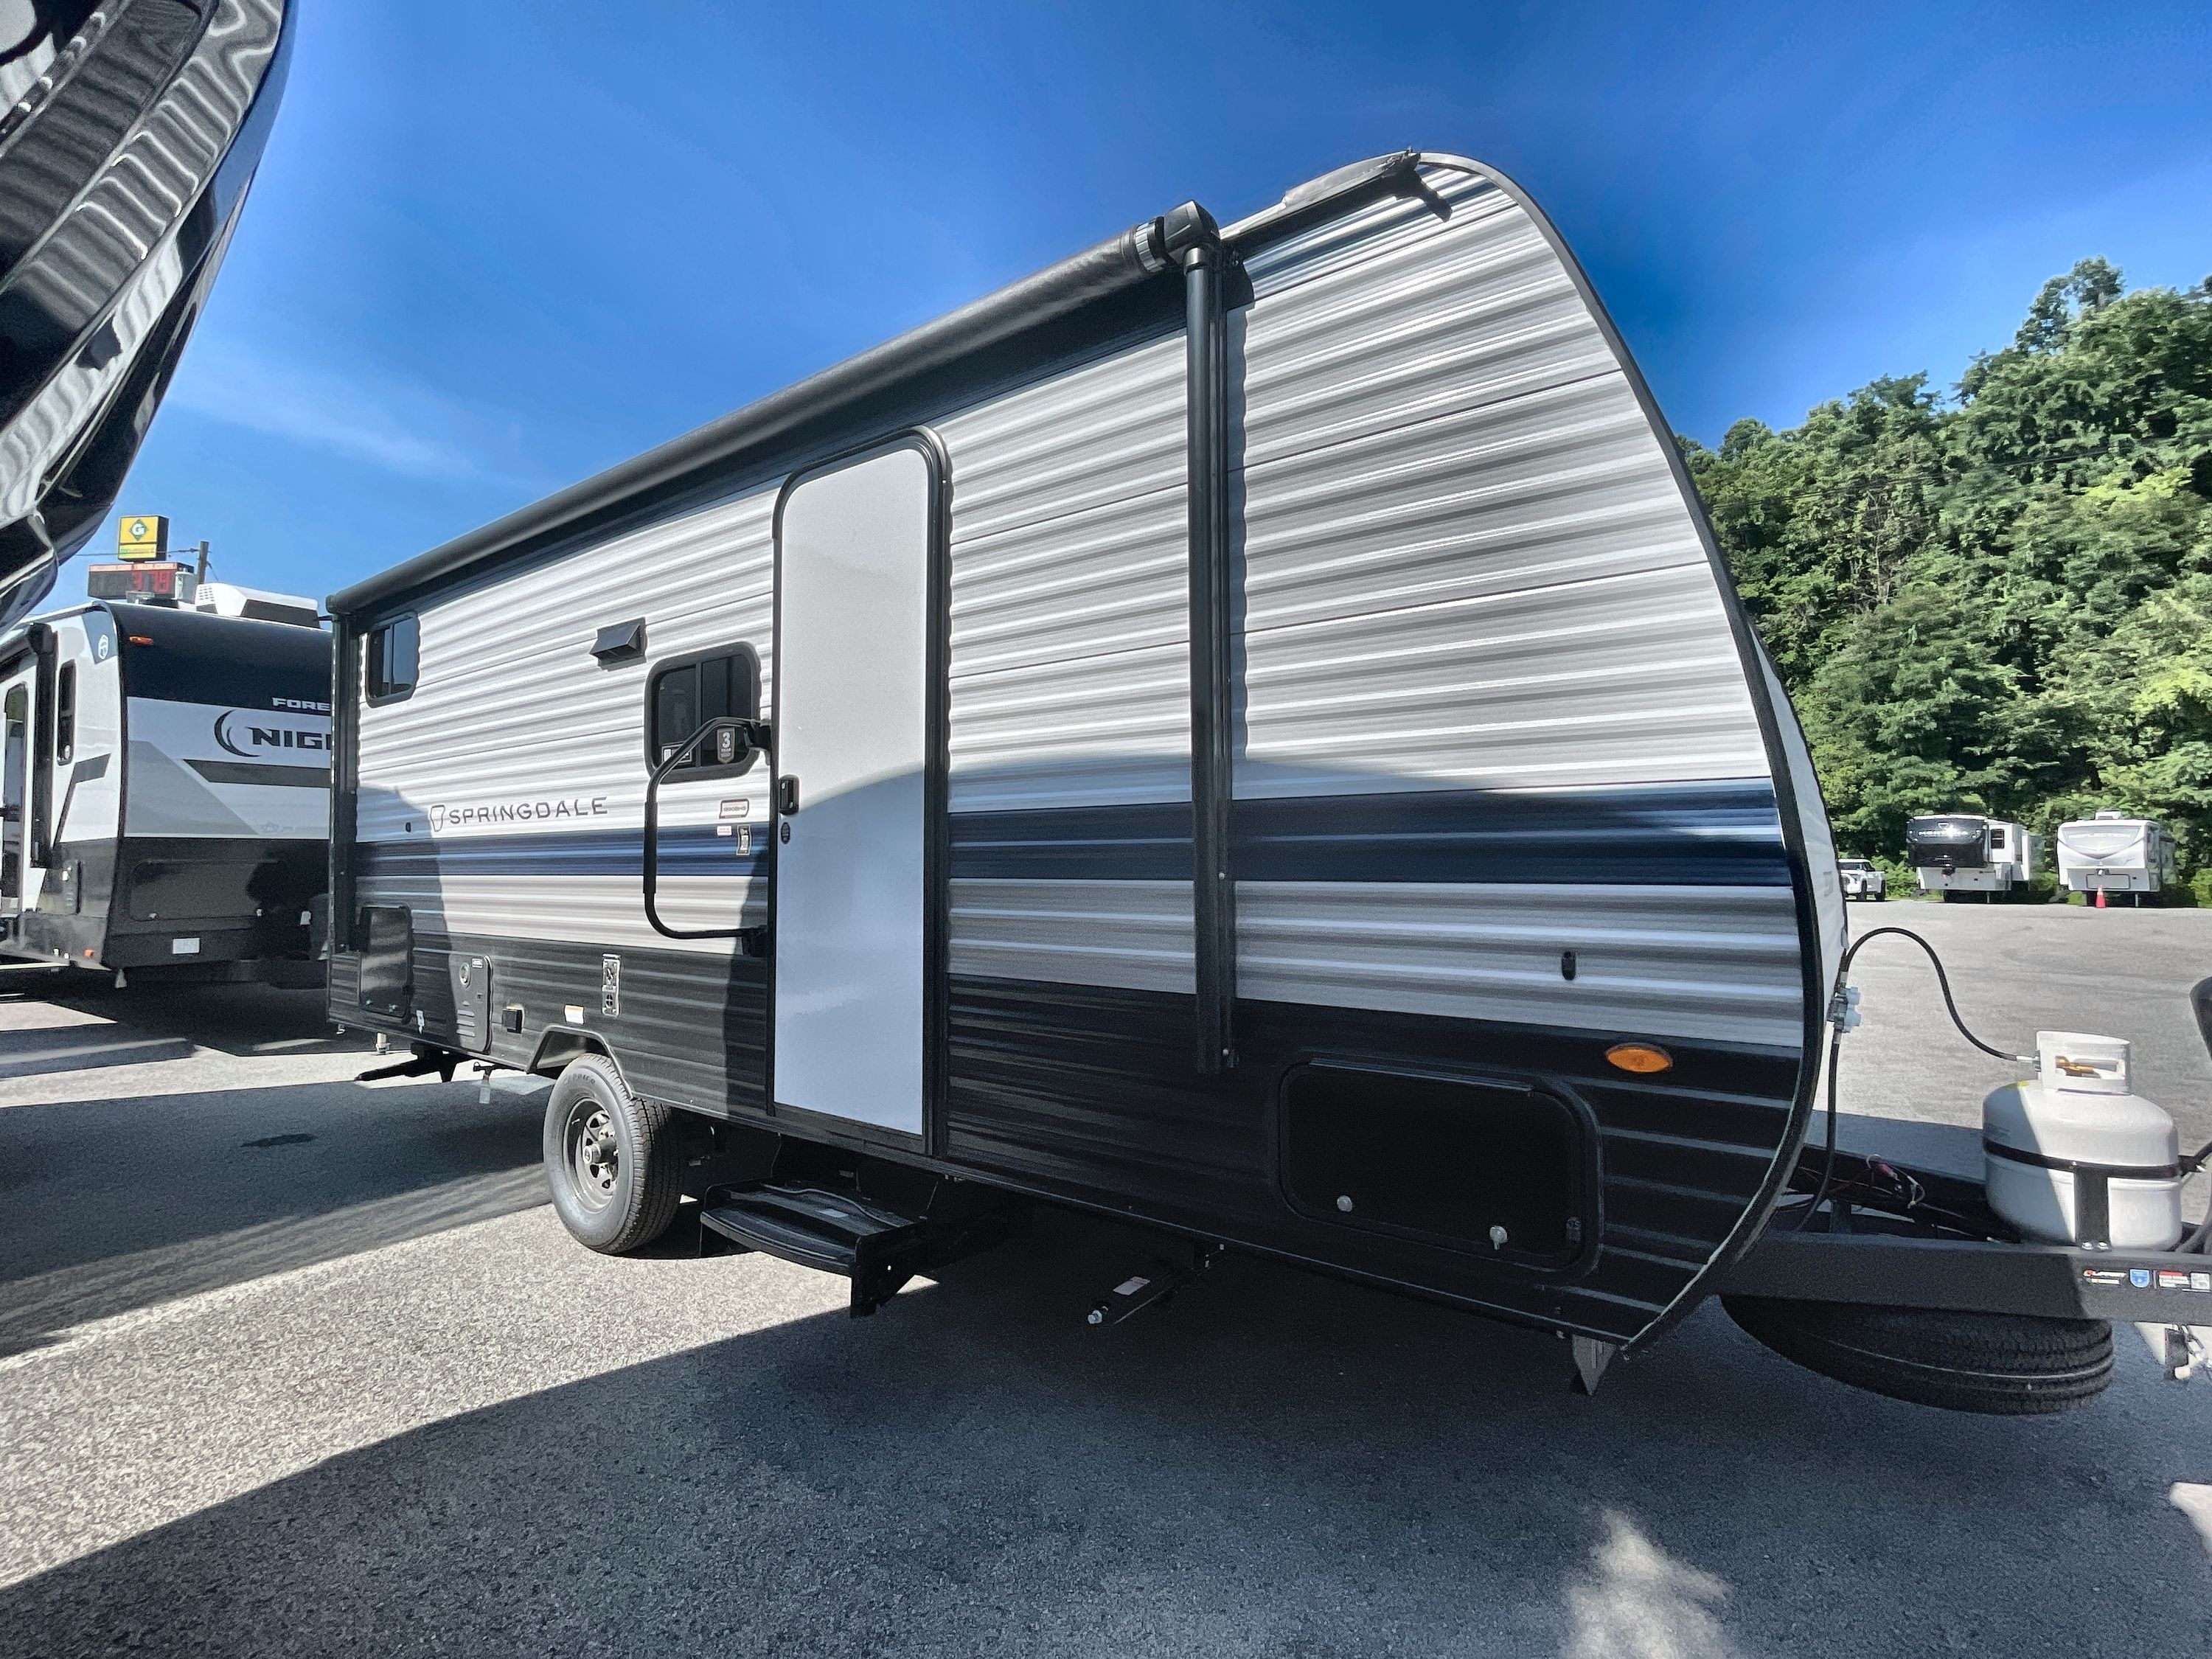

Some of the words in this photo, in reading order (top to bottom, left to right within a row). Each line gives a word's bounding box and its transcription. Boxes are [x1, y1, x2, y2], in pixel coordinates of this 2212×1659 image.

[272, 698, 331, 712] FORE
[246, 727, 331, 750] NIG
[723, 732, 730, 748] 3
[449, 796, 608, 824] SPRINGDALE
